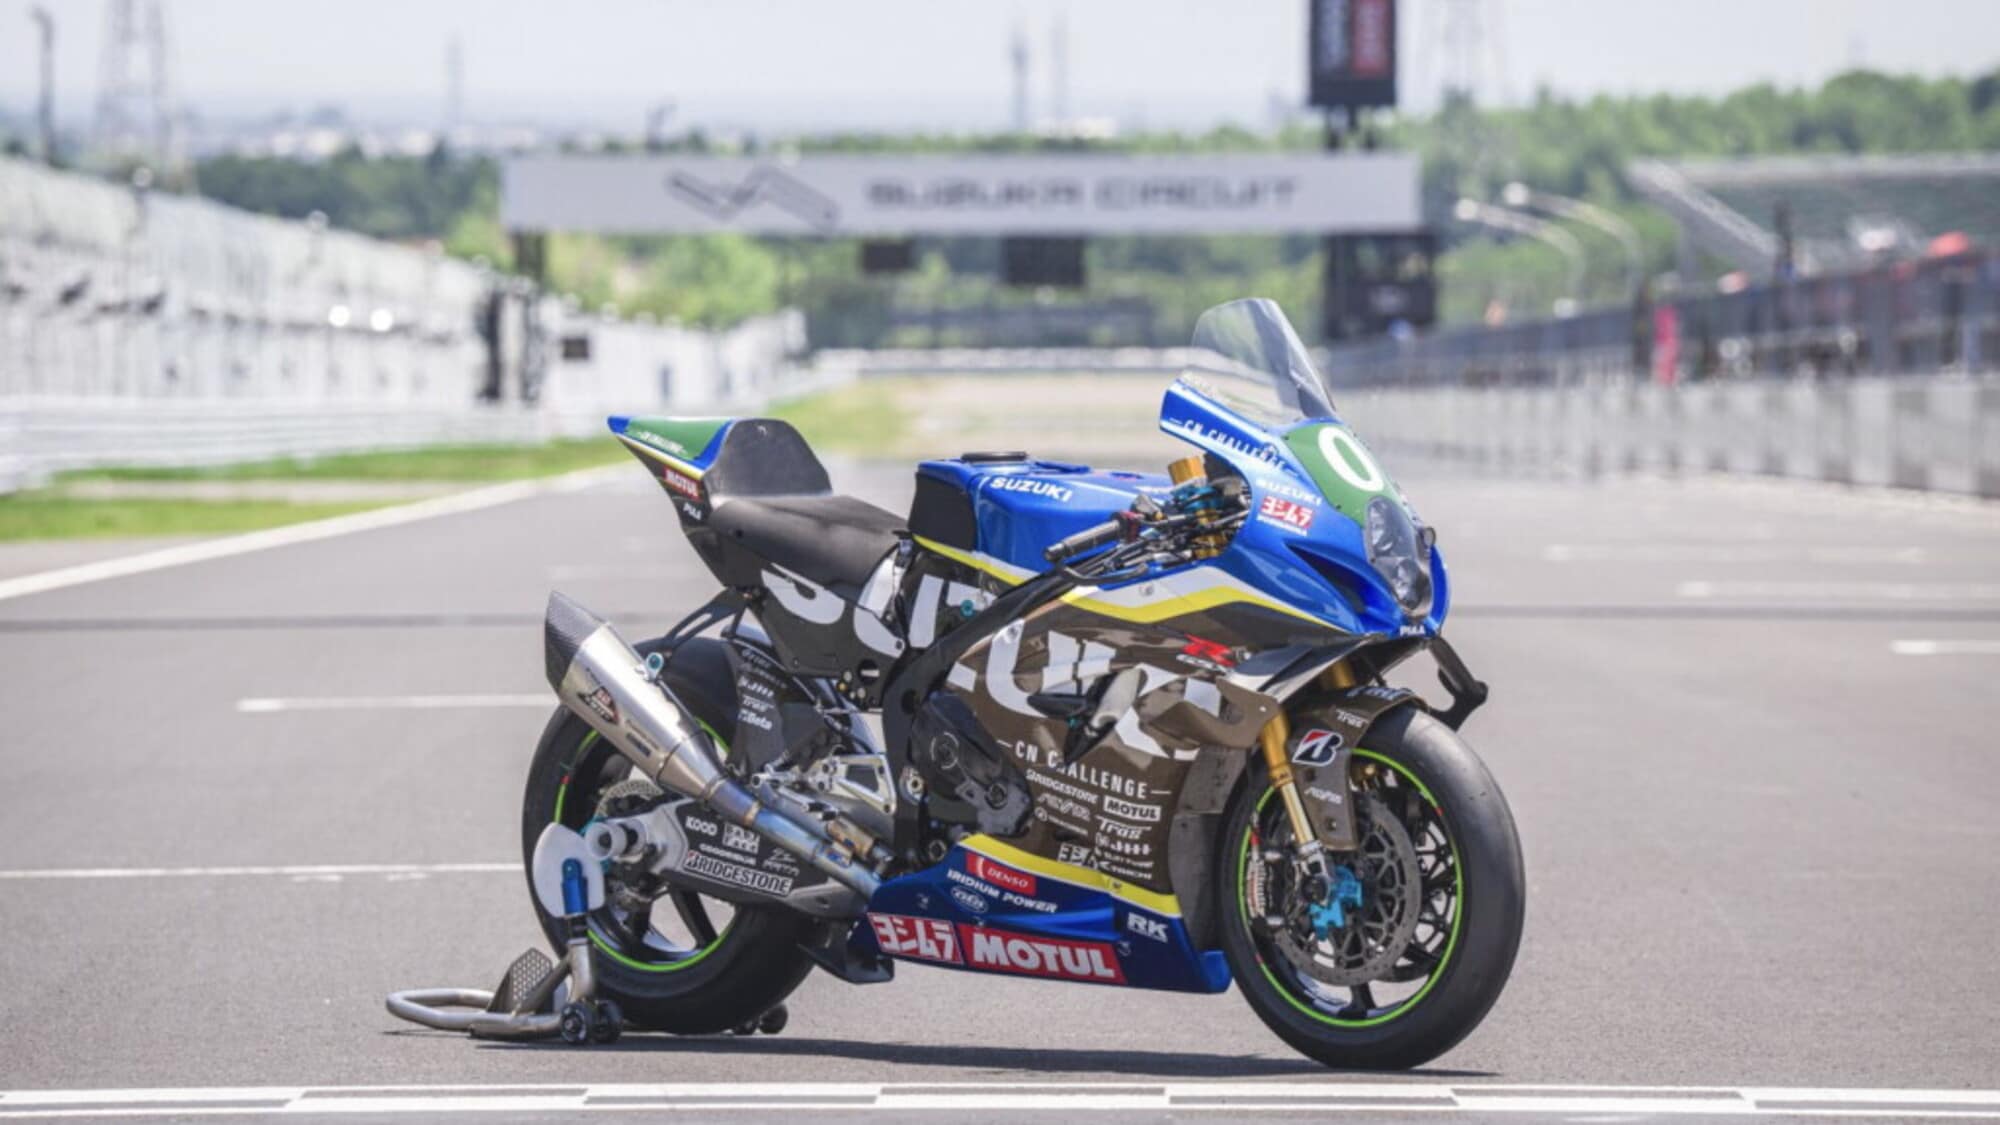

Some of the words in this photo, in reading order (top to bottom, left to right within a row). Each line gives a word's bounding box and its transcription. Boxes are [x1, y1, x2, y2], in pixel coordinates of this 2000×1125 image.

[1317, 426, 1384, 491] 0
[664, 468, 699, 498] MOTUL
[990, 476, 1073, 503] SUZUKI
[1256, 479, 1322, 507] SUZUKI
[1262, 496, 1313, 529] ヨシムラ
[1015, 741, 1038, 764] CN
[1047, 751, 1148, 799] CALLENGE
[1025, 768, 1099, 804] BRIDGESTONE
[1107, 801, 1157, 820] MOTUL
[687, 856, 793, 895] BRIDGESTONE
[946, 868, 1000, 899] IRIDIUM
[1002, 891, 1058, 915] POWER
[987, 867, 1029, 890] DENSO
[873, 915, 956, 961] ヨシムラ
[1126, 912, 1169, 941] RK
[972, 933, 1116, 978] MOTUL
